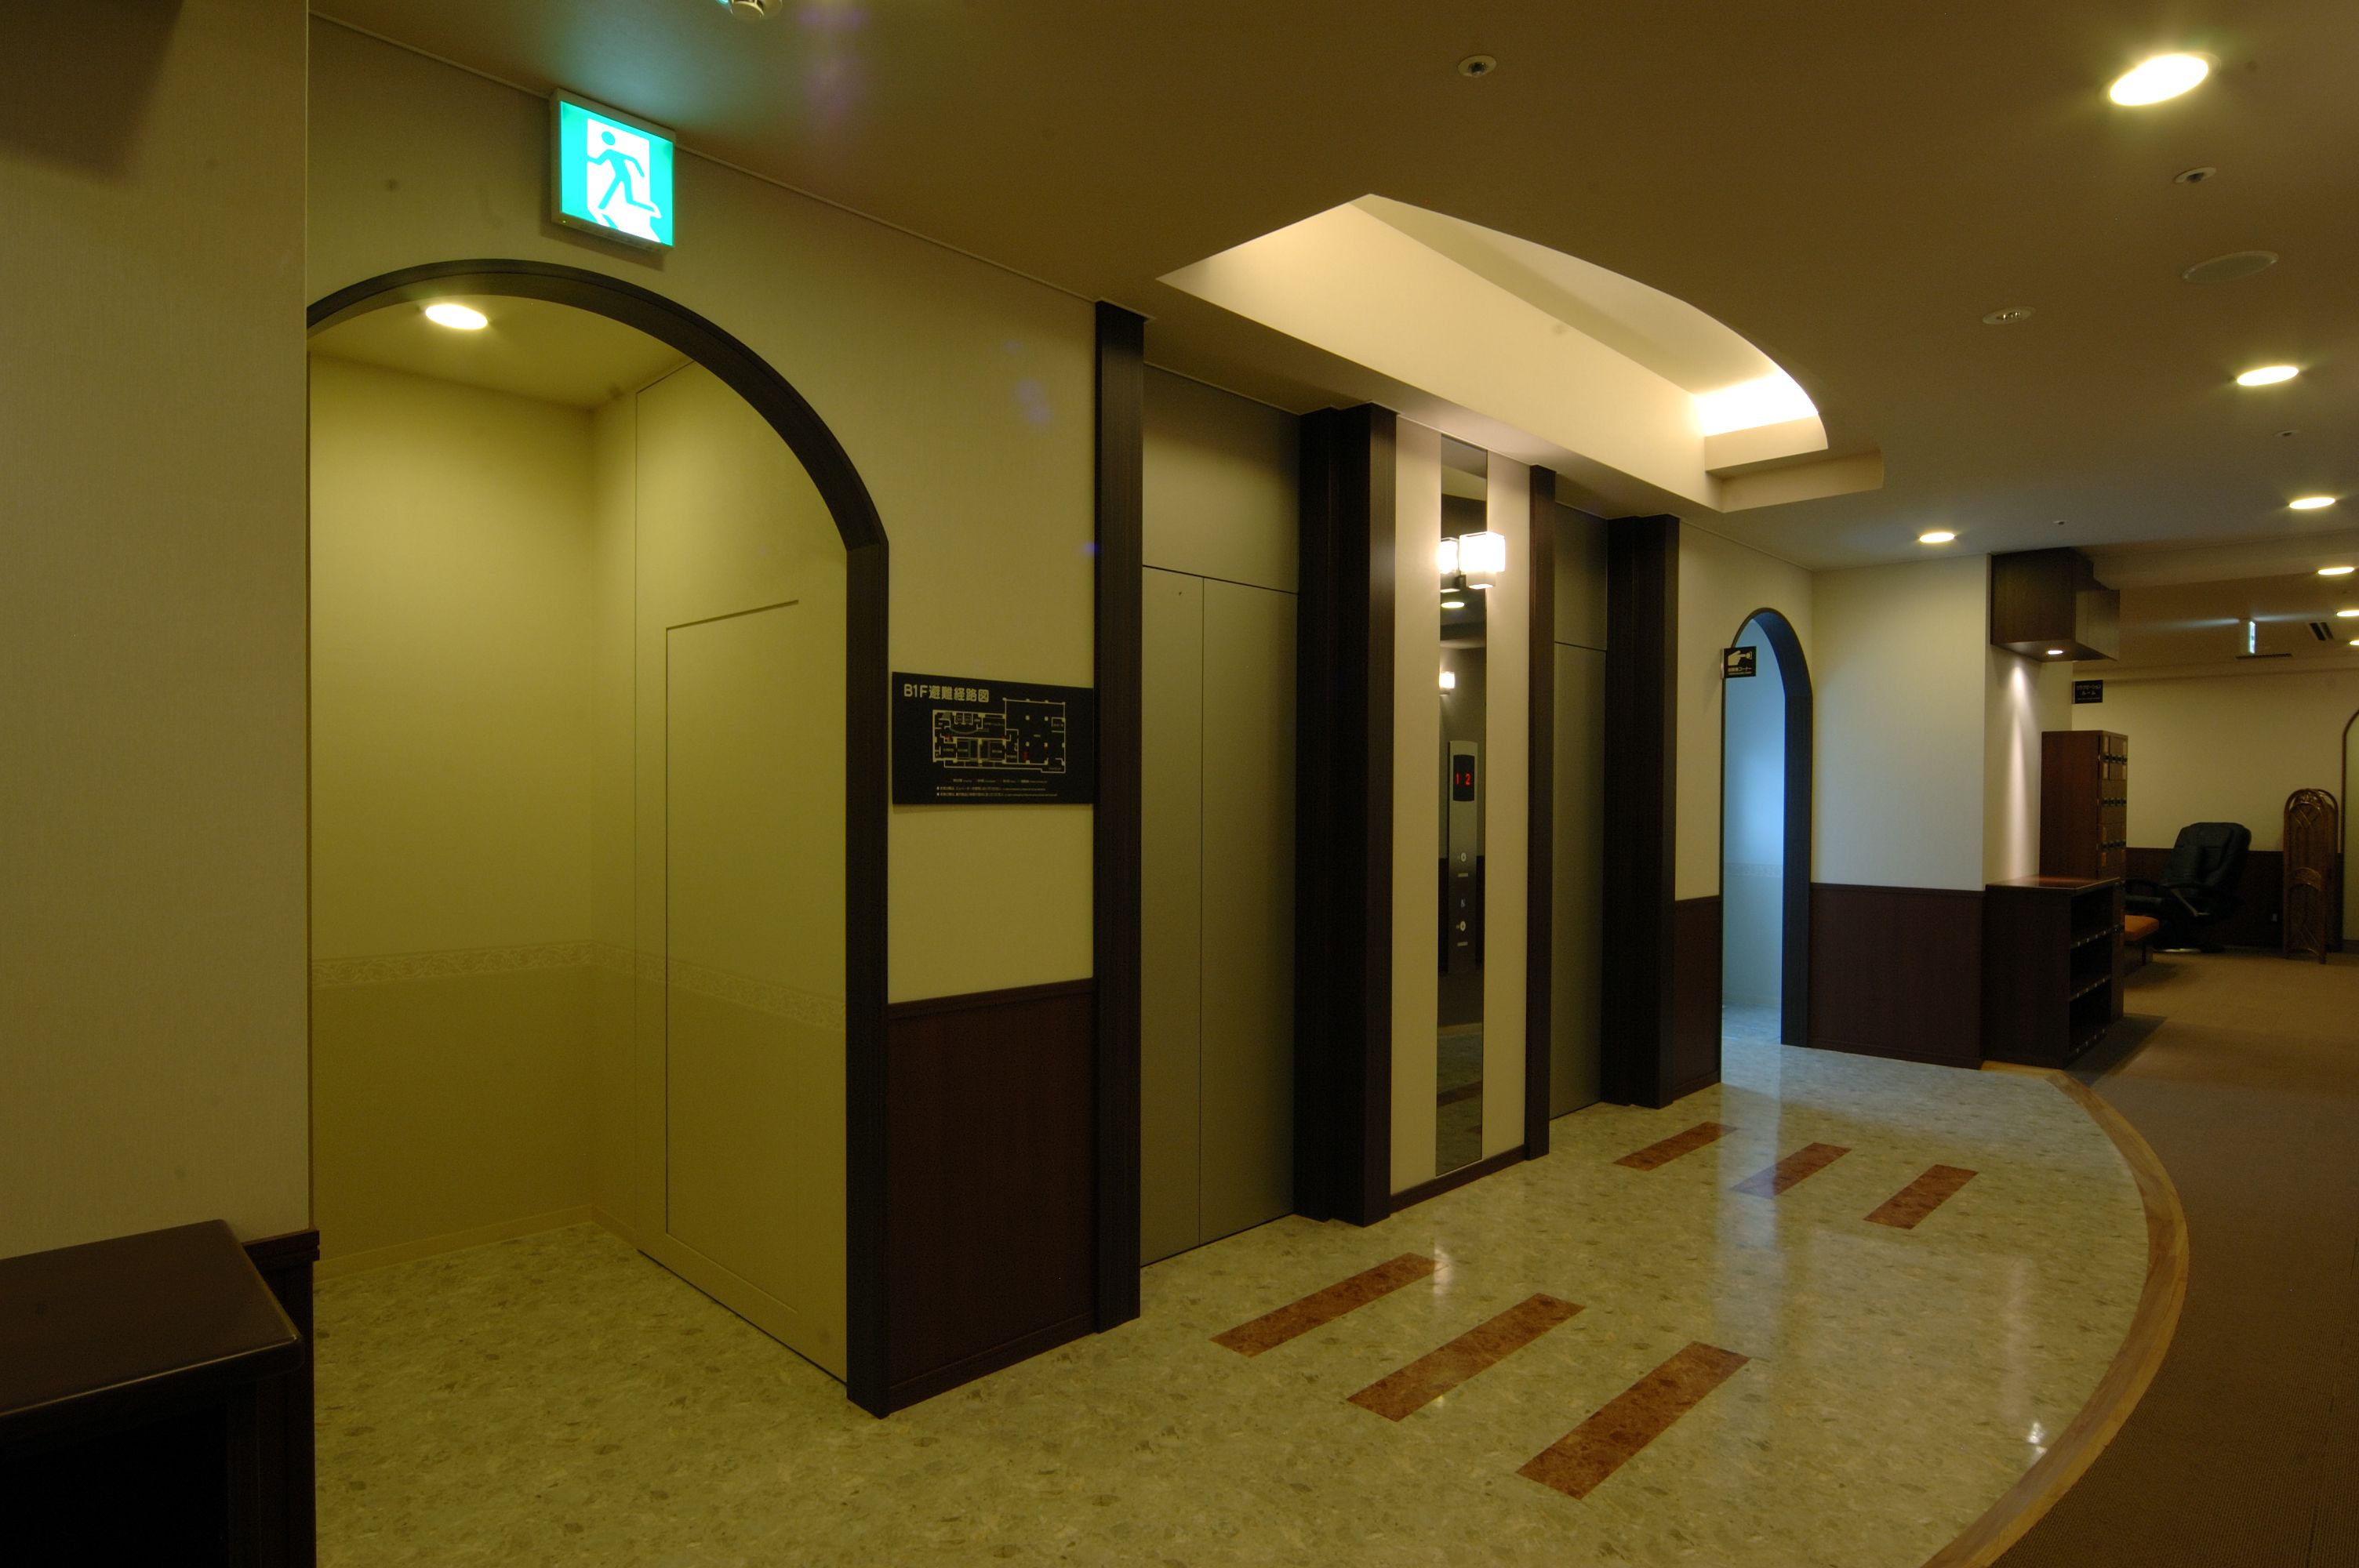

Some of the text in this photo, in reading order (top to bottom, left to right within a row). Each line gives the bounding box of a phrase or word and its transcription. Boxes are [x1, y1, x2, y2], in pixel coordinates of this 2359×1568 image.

[903, 683, 990, 703] B1F避難経路図
